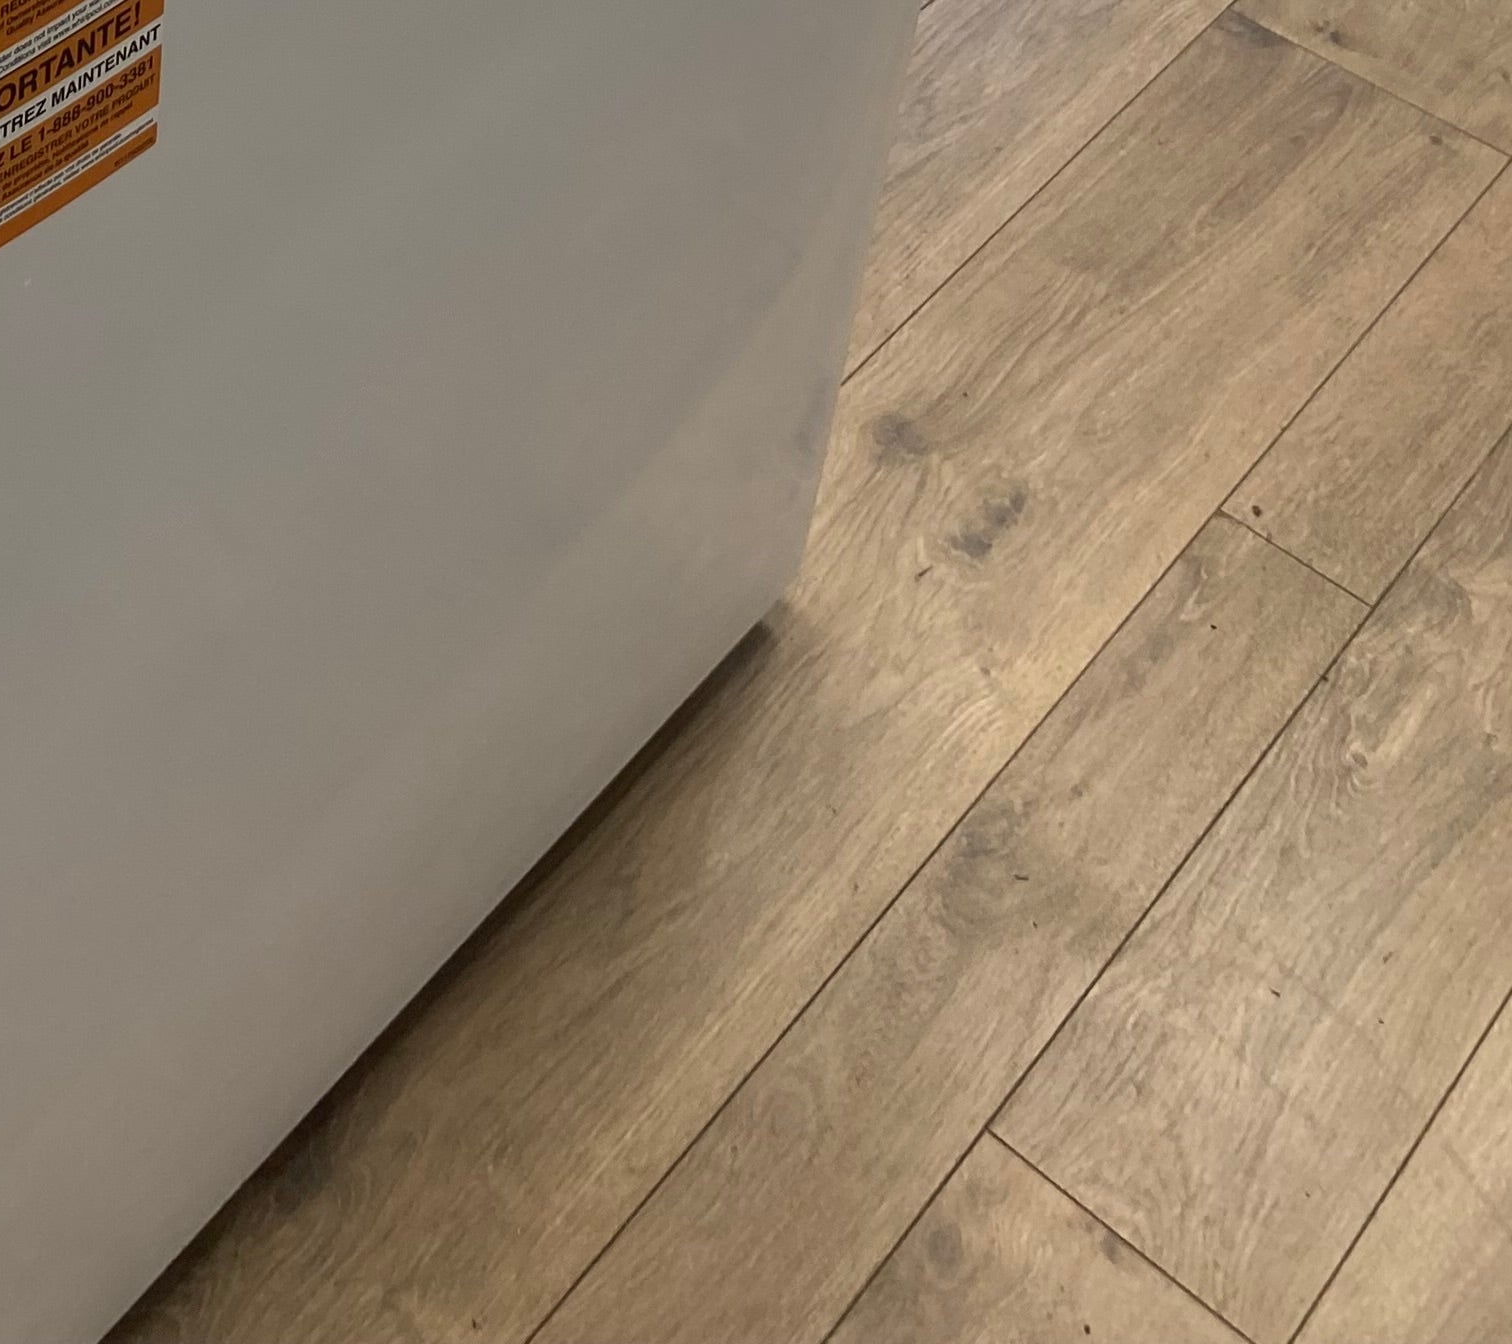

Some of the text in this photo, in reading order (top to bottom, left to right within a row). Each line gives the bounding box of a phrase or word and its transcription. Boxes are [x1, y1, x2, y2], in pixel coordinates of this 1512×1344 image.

[10, 133, 32, 160] LE
[38, 54, 153, 143] 1-888-900-3381
[51, 23, 160, 107] MAINTENANT
[74, 104, 108, 135] VOTRE
[111, 72, 155, 110] PRODUIT
